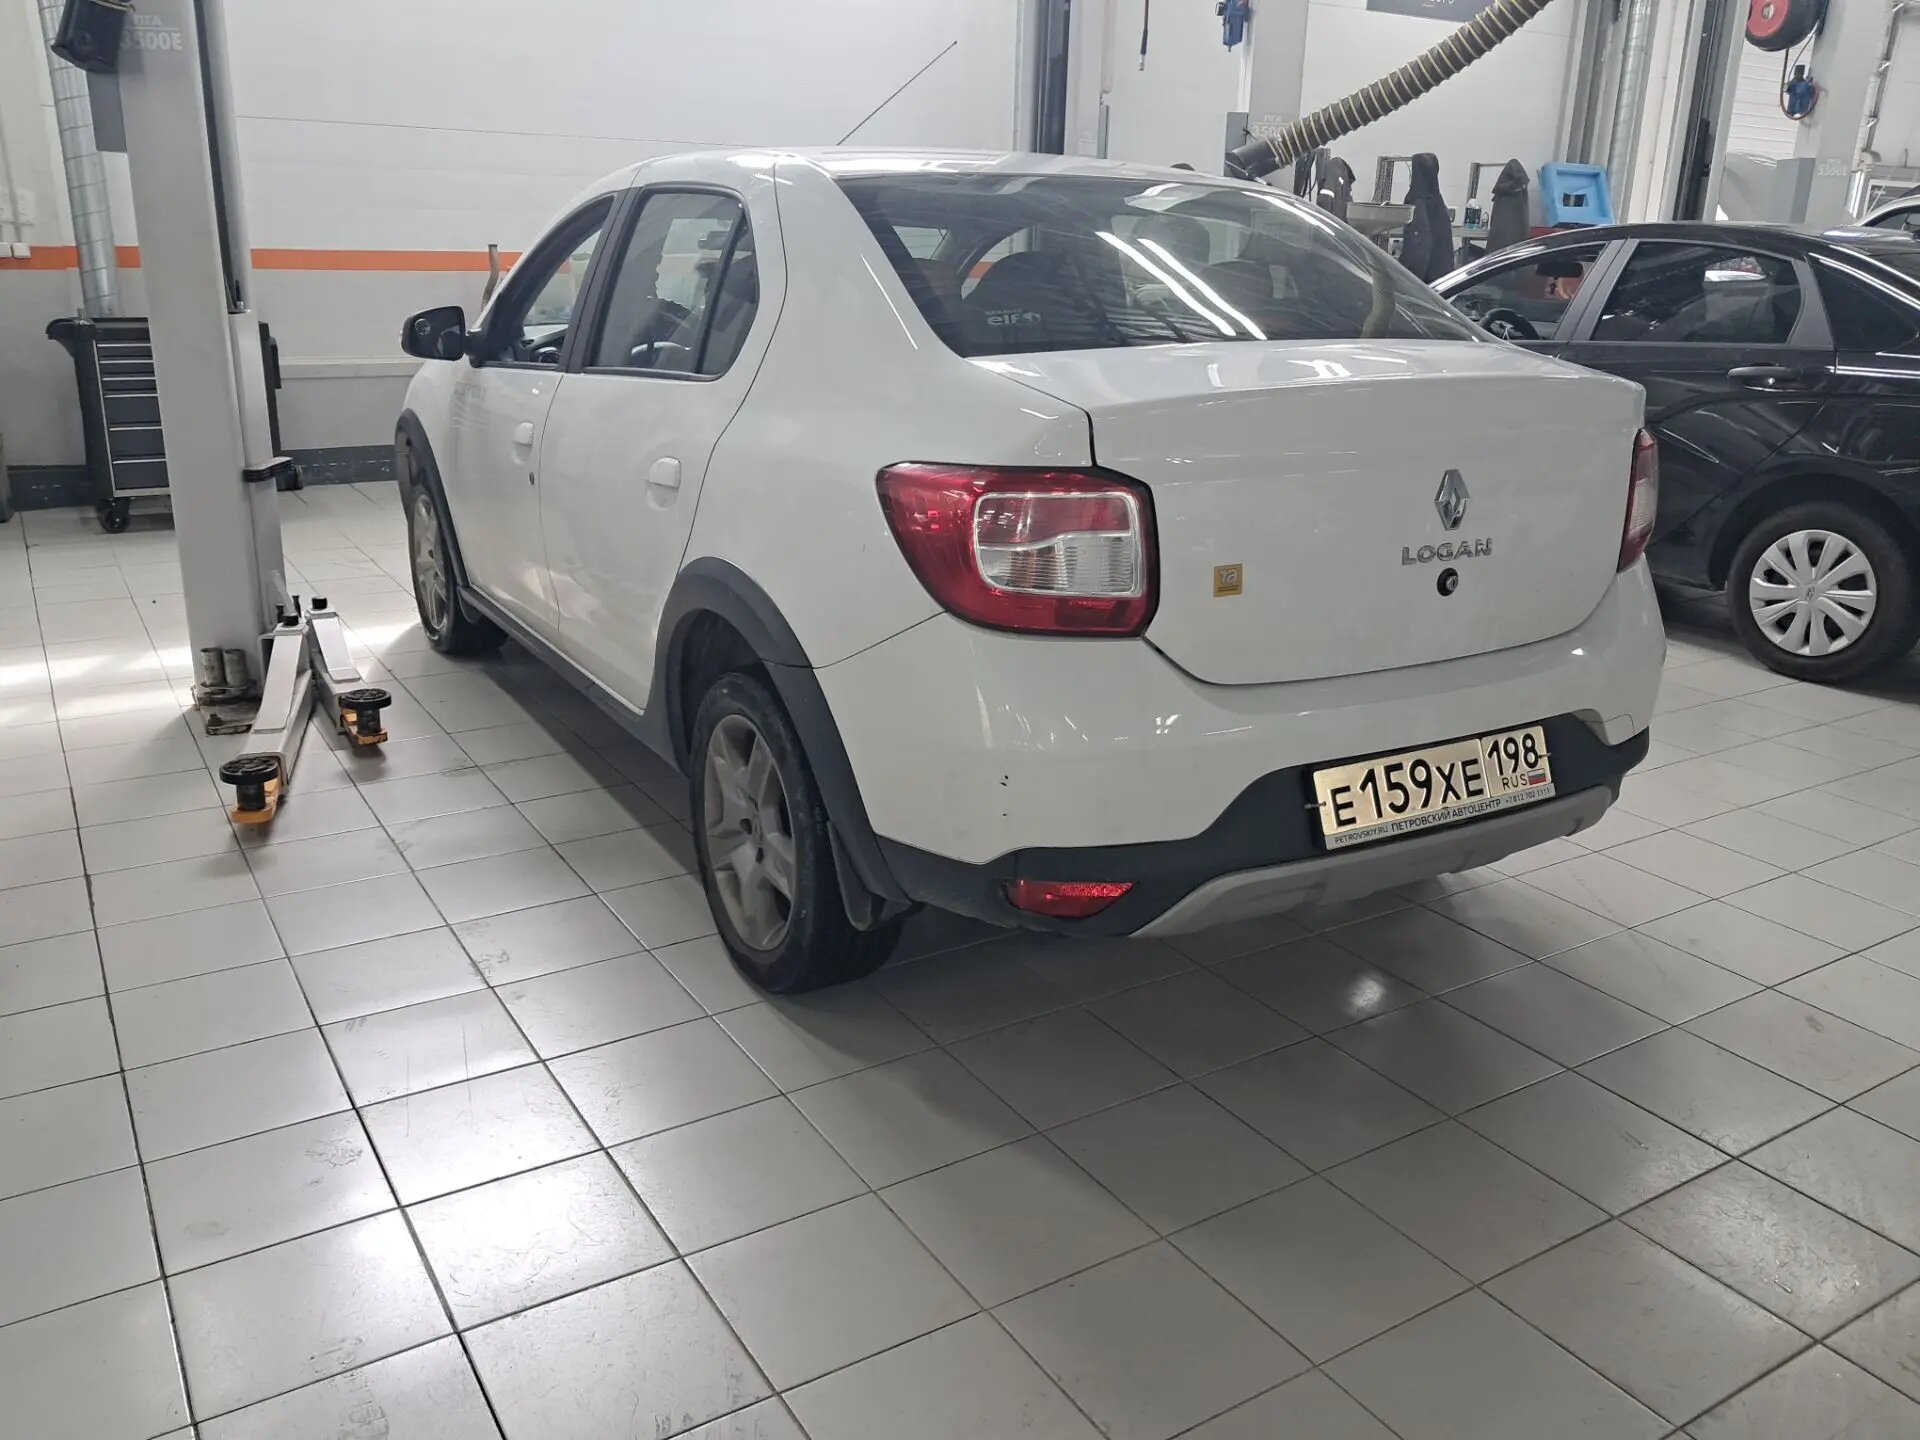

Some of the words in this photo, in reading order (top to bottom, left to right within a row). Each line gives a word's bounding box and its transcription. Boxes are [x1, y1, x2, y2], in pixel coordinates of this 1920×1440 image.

[1402, 538, 1493, 566] LOGAN
[1486, 733, 1540, 777] 198
[1502, 773, 1528, 791] RUS
[1335, 826, 1388, 844] PETROVSKIY.RU
[1391, 810, 1450, 833] ПЕТРОВСКИЙ
[1452, 799, 1501, 818] АВТОЦЕНТР
